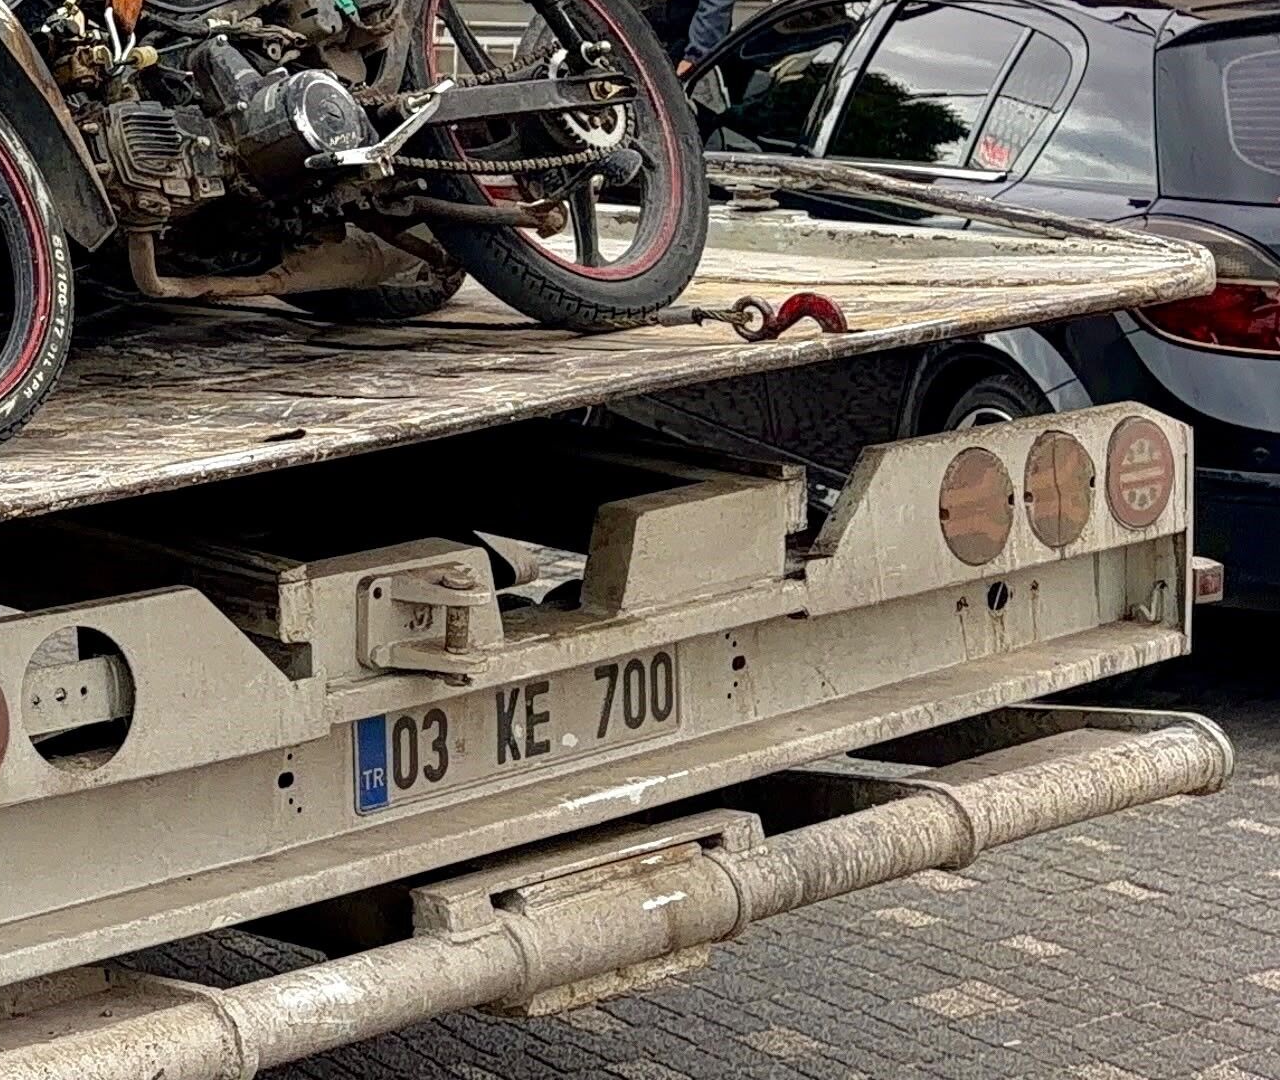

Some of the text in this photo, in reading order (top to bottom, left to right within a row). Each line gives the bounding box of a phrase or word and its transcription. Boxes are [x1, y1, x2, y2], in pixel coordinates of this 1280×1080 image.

[392, 651, 674, 790] 03 KE 700
[362, 768, 385, 791] TR
